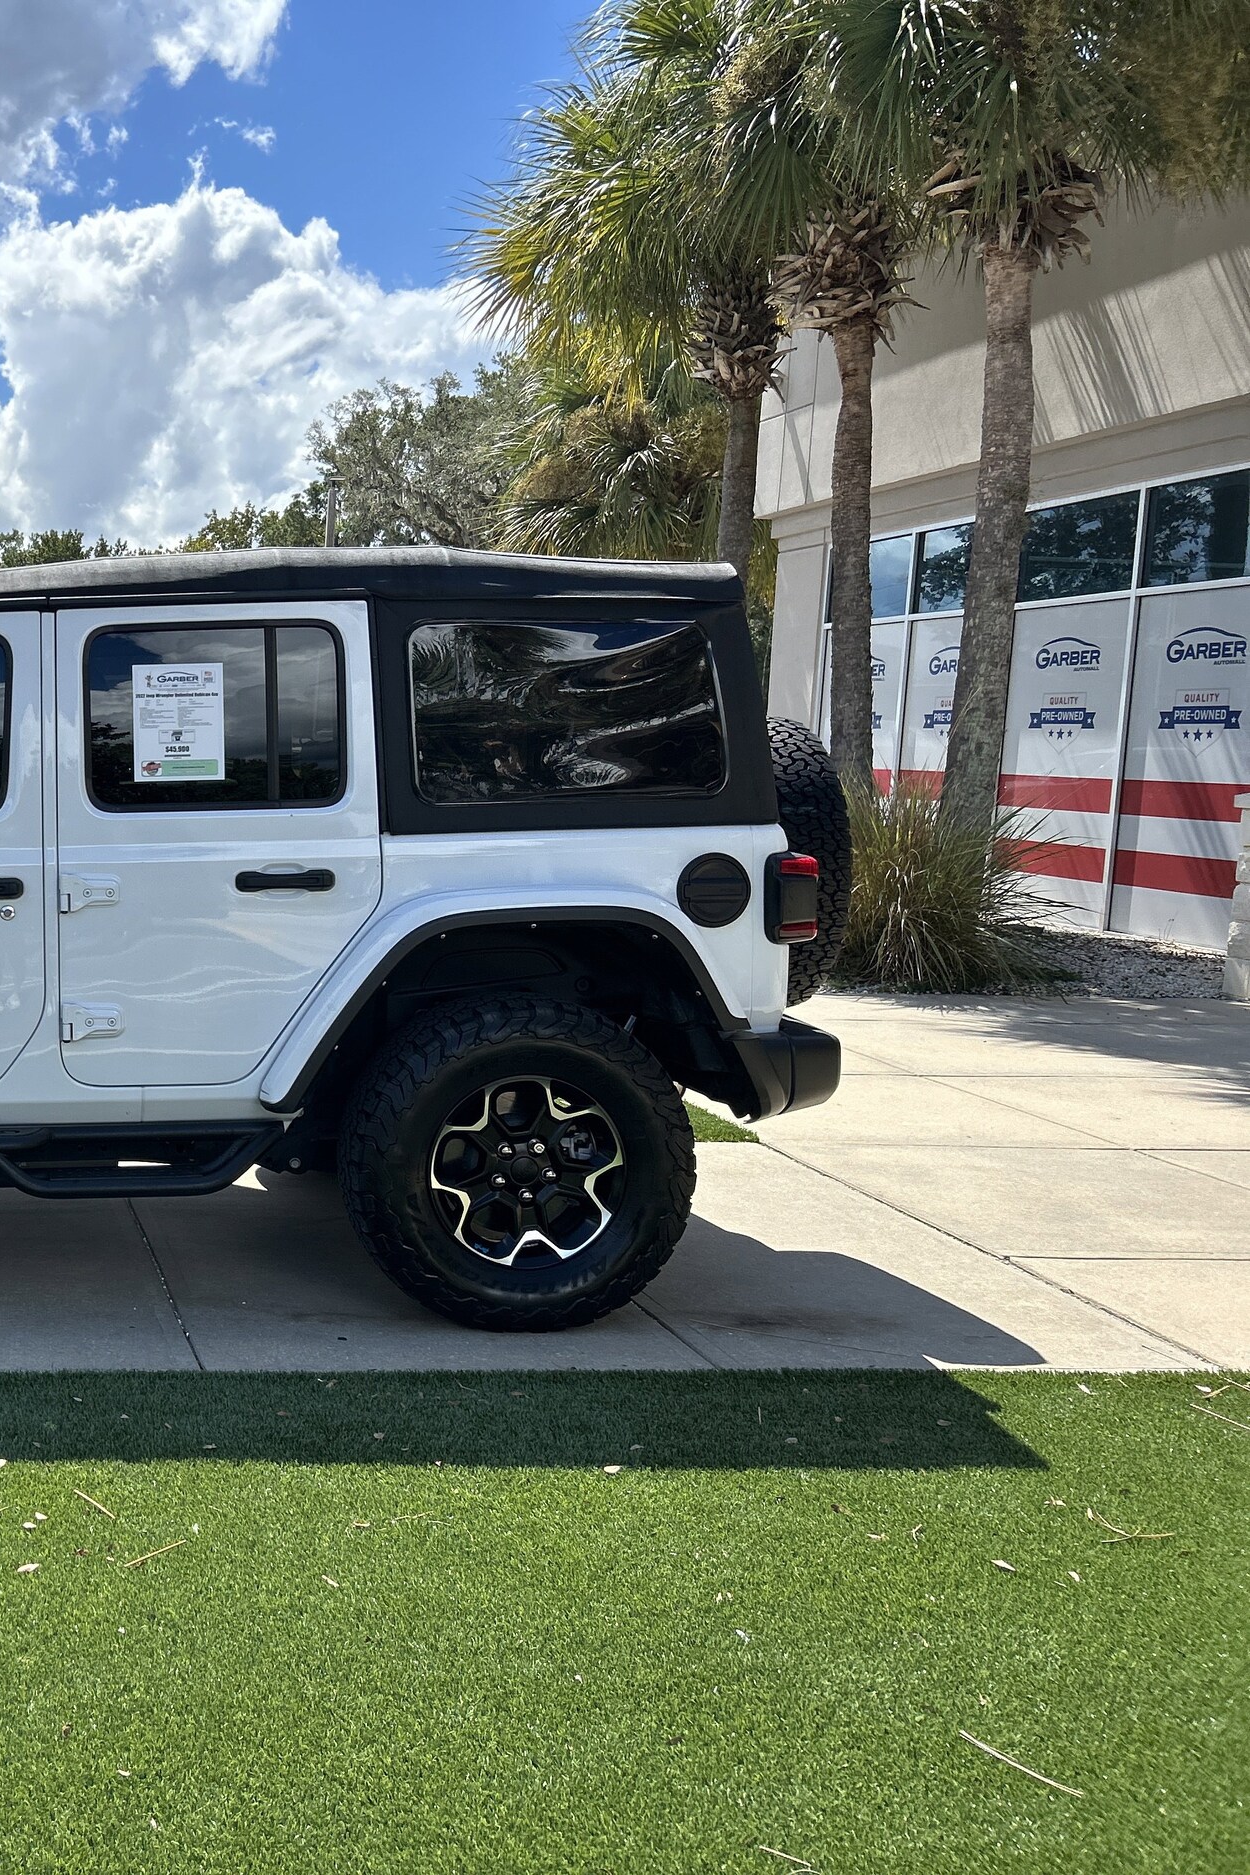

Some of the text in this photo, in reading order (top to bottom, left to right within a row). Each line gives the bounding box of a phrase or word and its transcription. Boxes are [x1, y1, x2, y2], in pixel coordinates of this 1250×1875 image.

[1166, 639, 1247, 664] GARBER
[1035, 648, 1101, 670] GARBER
[929, 656, 958, 676] GAR
[156, 675, 199, 683] GARBER
[1049, 696, 1079, 705] QUALITY
[1184, 693, 1220, 703] QUALITY
[933, 712, 952, 722] PRE-O
[1041, 711, 1084, 721] PRE-OWNED
[1173, 709, 1227, 720] PRE-OWNED
